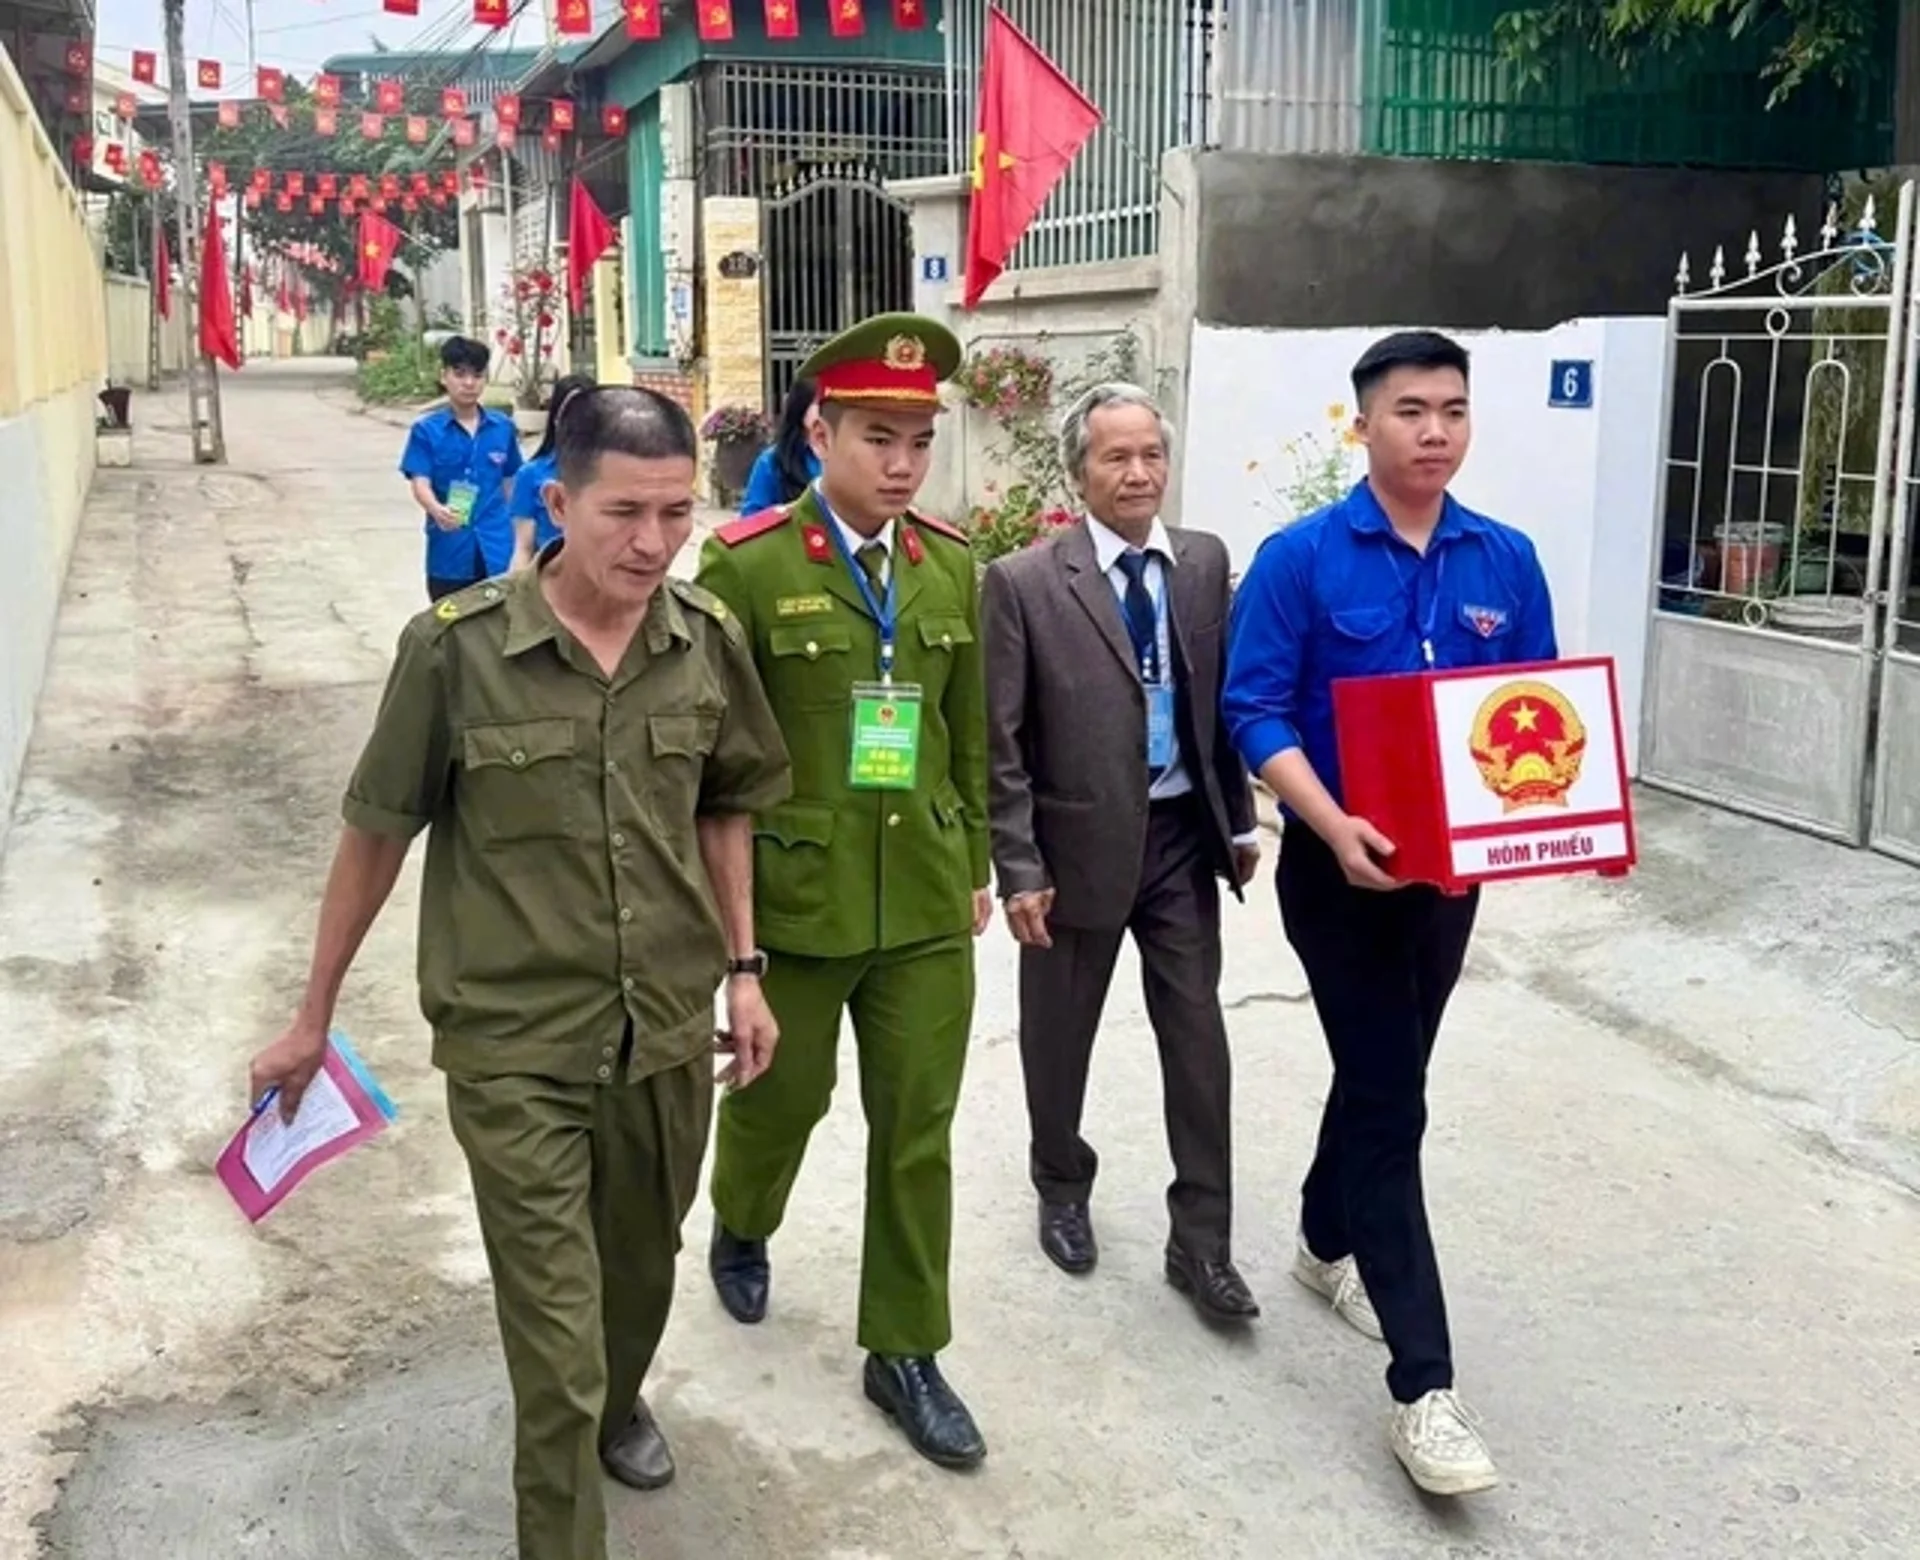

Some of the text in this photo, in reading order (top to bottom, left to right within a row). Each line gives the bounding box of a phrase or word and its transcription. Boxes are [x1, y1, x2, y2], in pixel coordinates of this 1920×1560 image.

[1563, 367, 1579, 397] 6
[1487, 831, 1594, 865] HÒM PHIẾU
